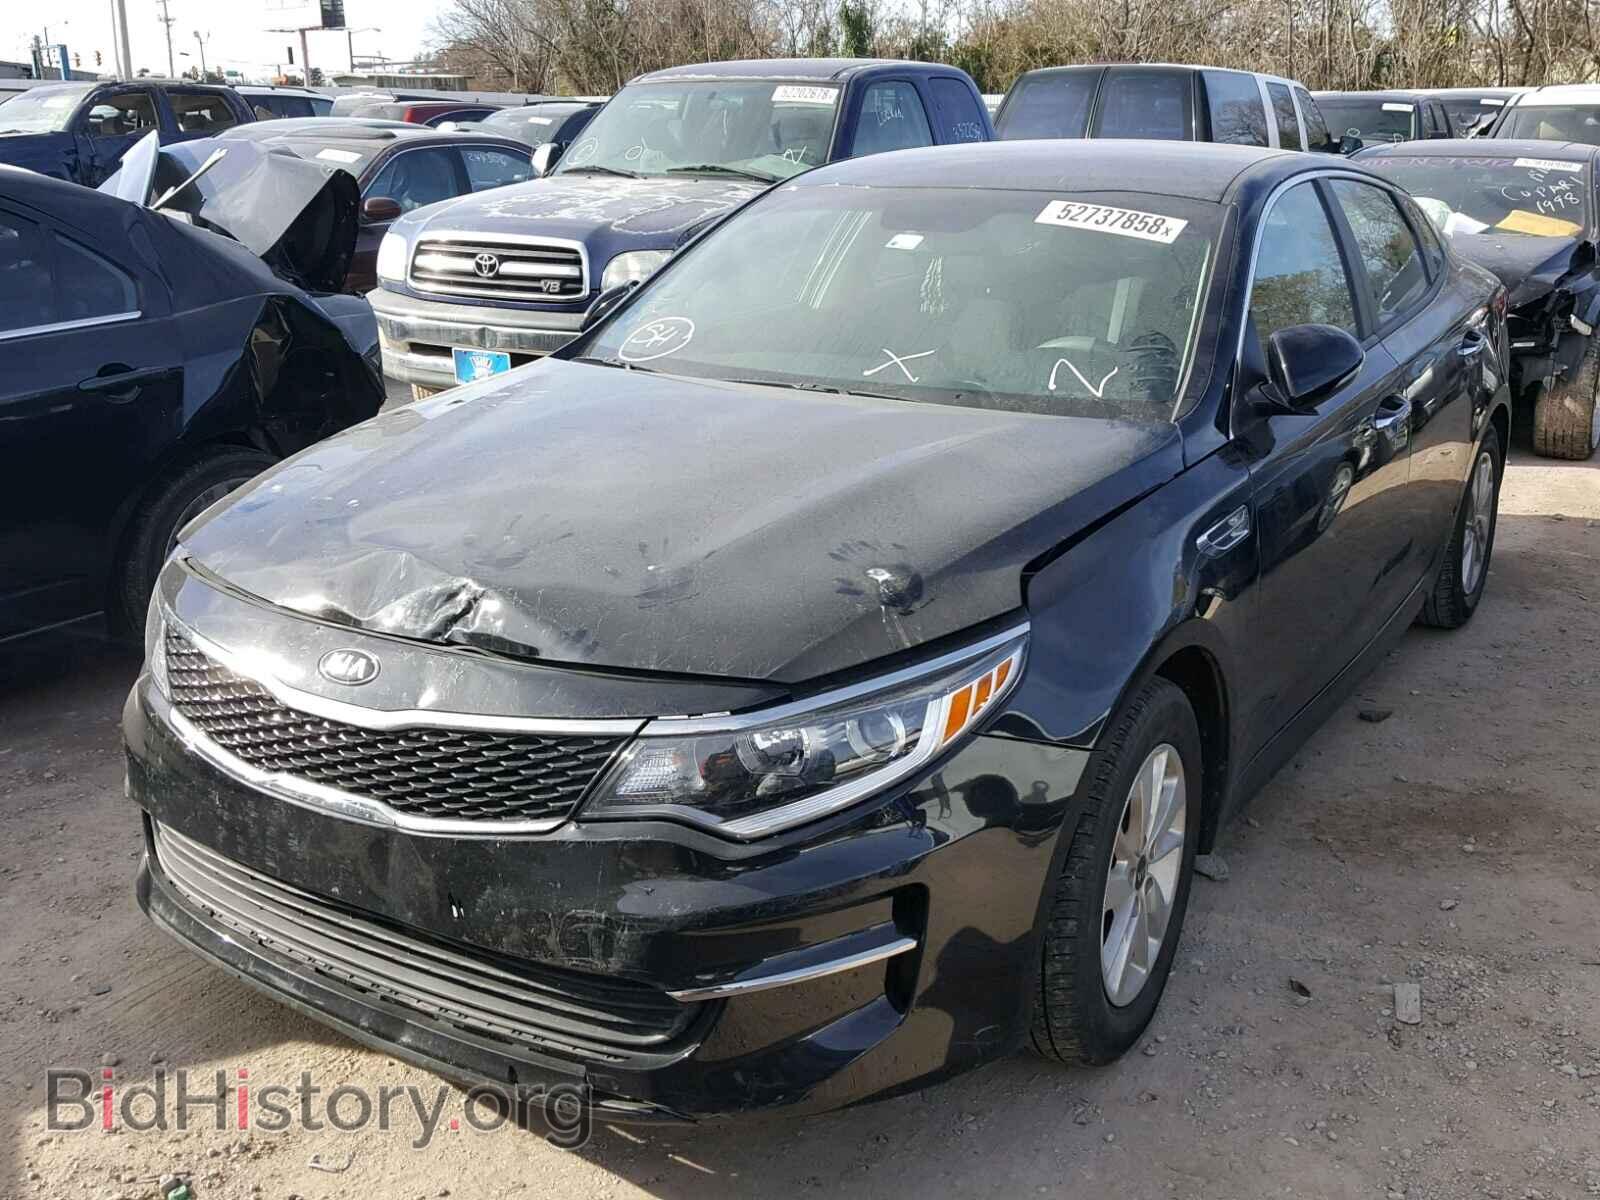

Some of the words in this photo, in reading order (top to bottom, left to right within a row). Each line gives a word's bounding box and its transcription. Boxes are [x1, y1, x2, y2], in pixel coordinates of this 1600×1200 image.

[1536, 192, 1580, 213] 1998
[541, 279, 561, 293] V8
[863, 348, 938, 383] X
